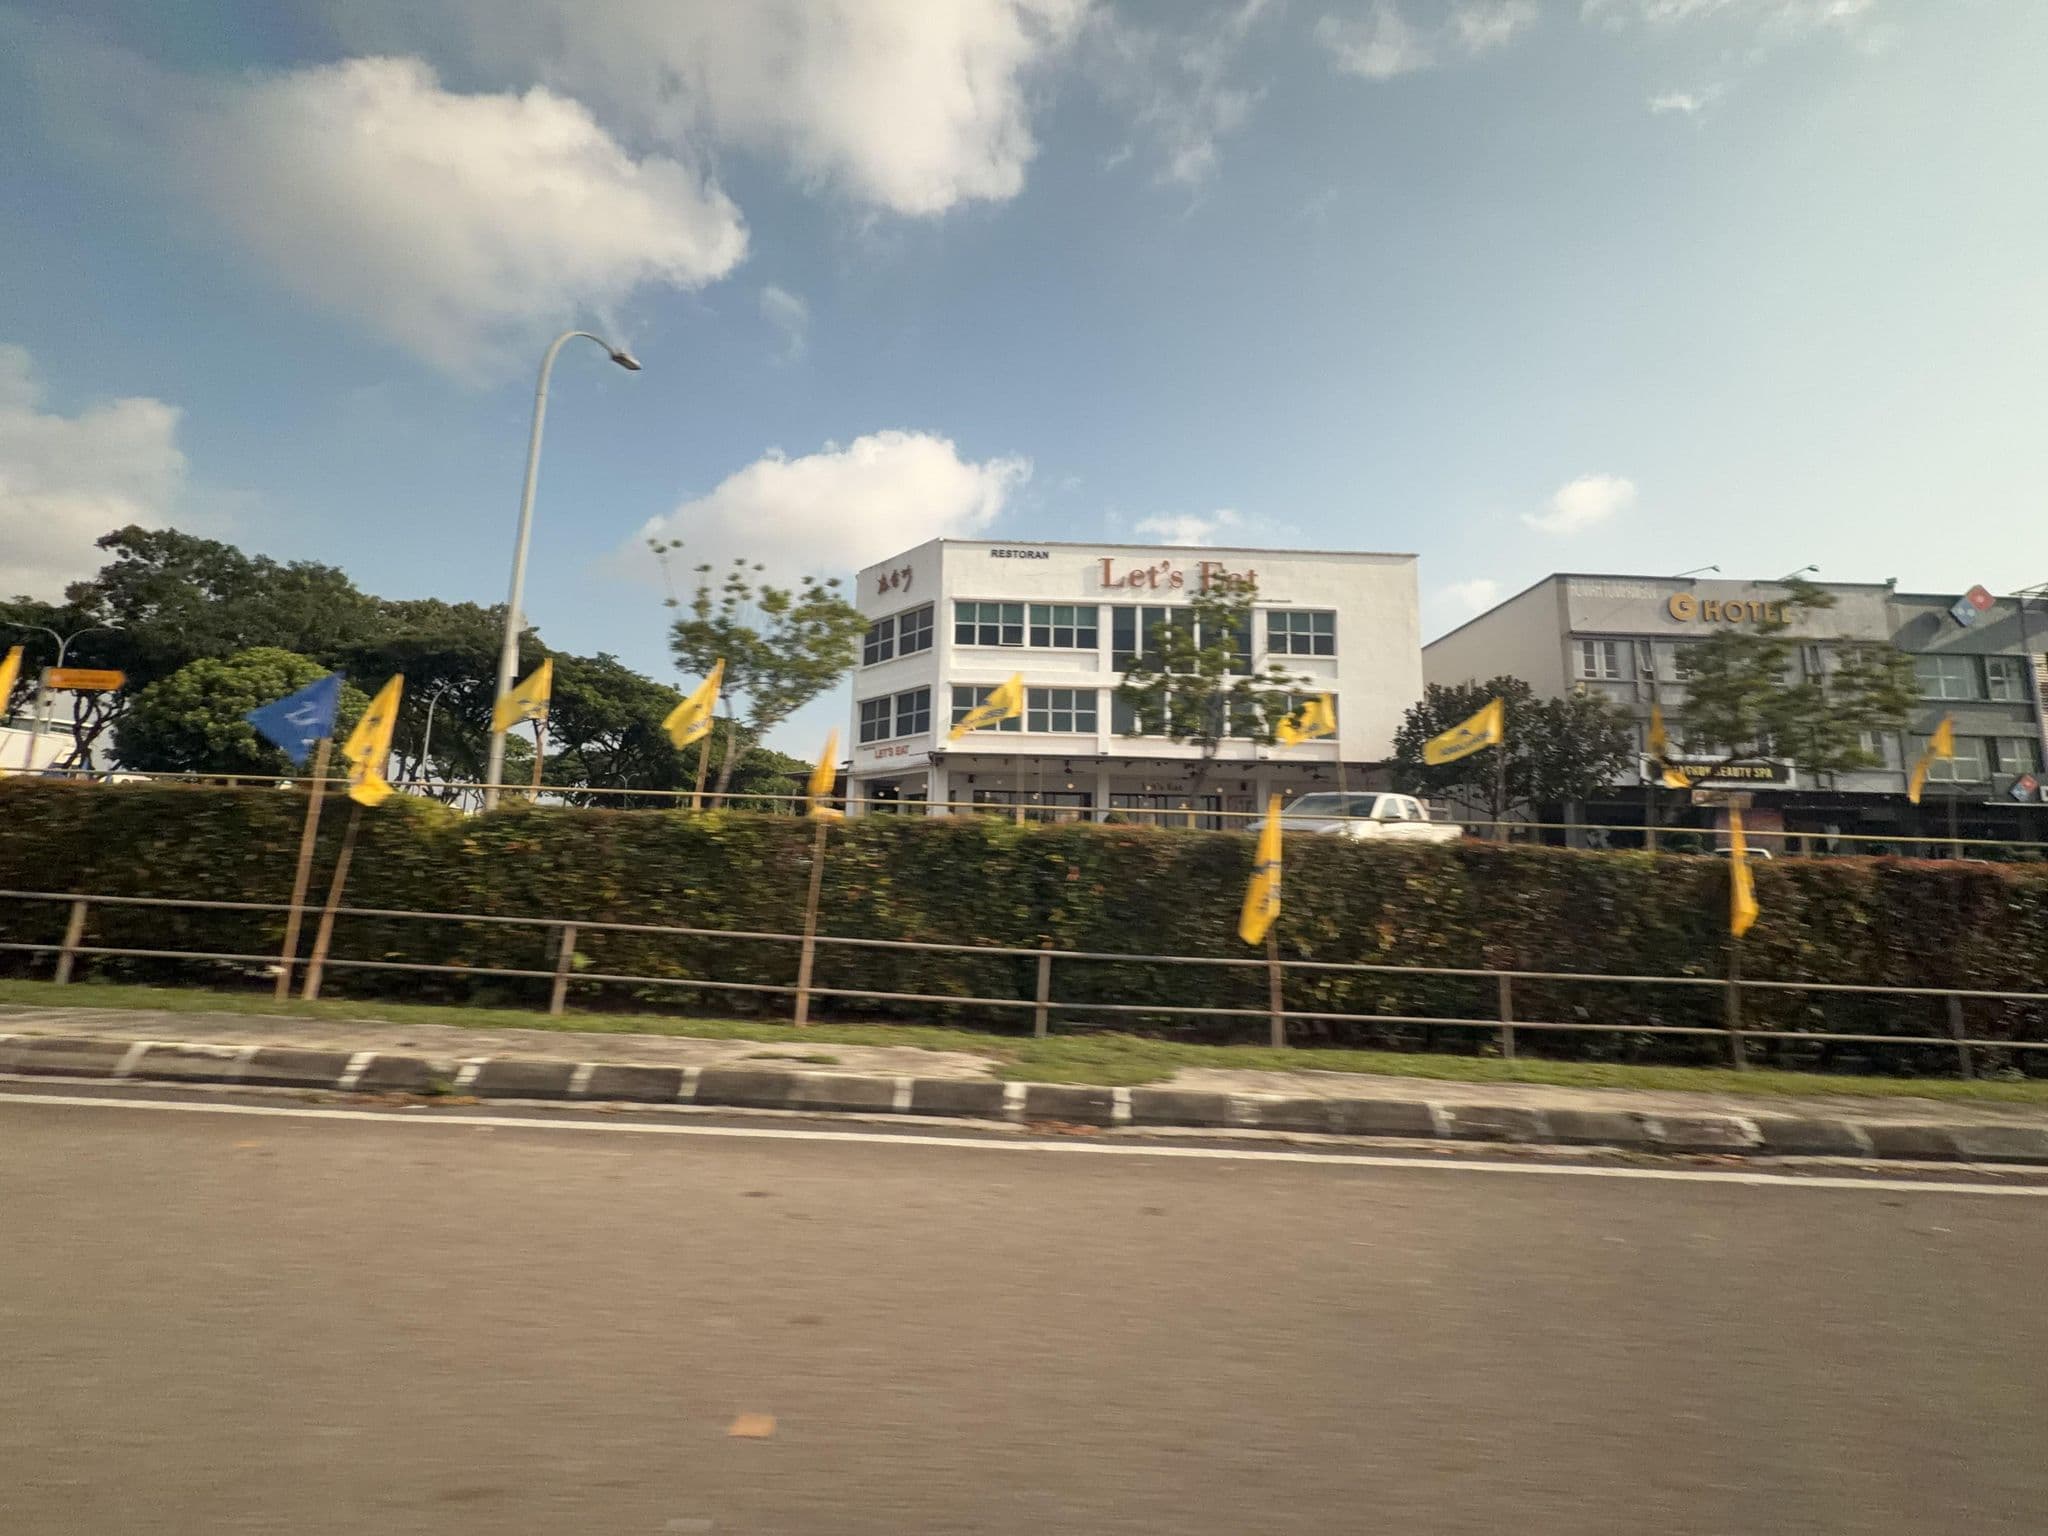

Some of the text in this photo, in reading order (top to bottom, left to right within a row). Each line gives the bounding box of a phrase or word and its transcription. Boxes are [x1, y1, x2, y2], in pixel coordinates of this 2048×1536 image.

[991, 549, 1049, 559] RESTORAN
[1098, 557, 1184, 589] Let's
[1668, 591, 1794, 625] G HOTEL
[1753, 767, 1773, 778] SPA
